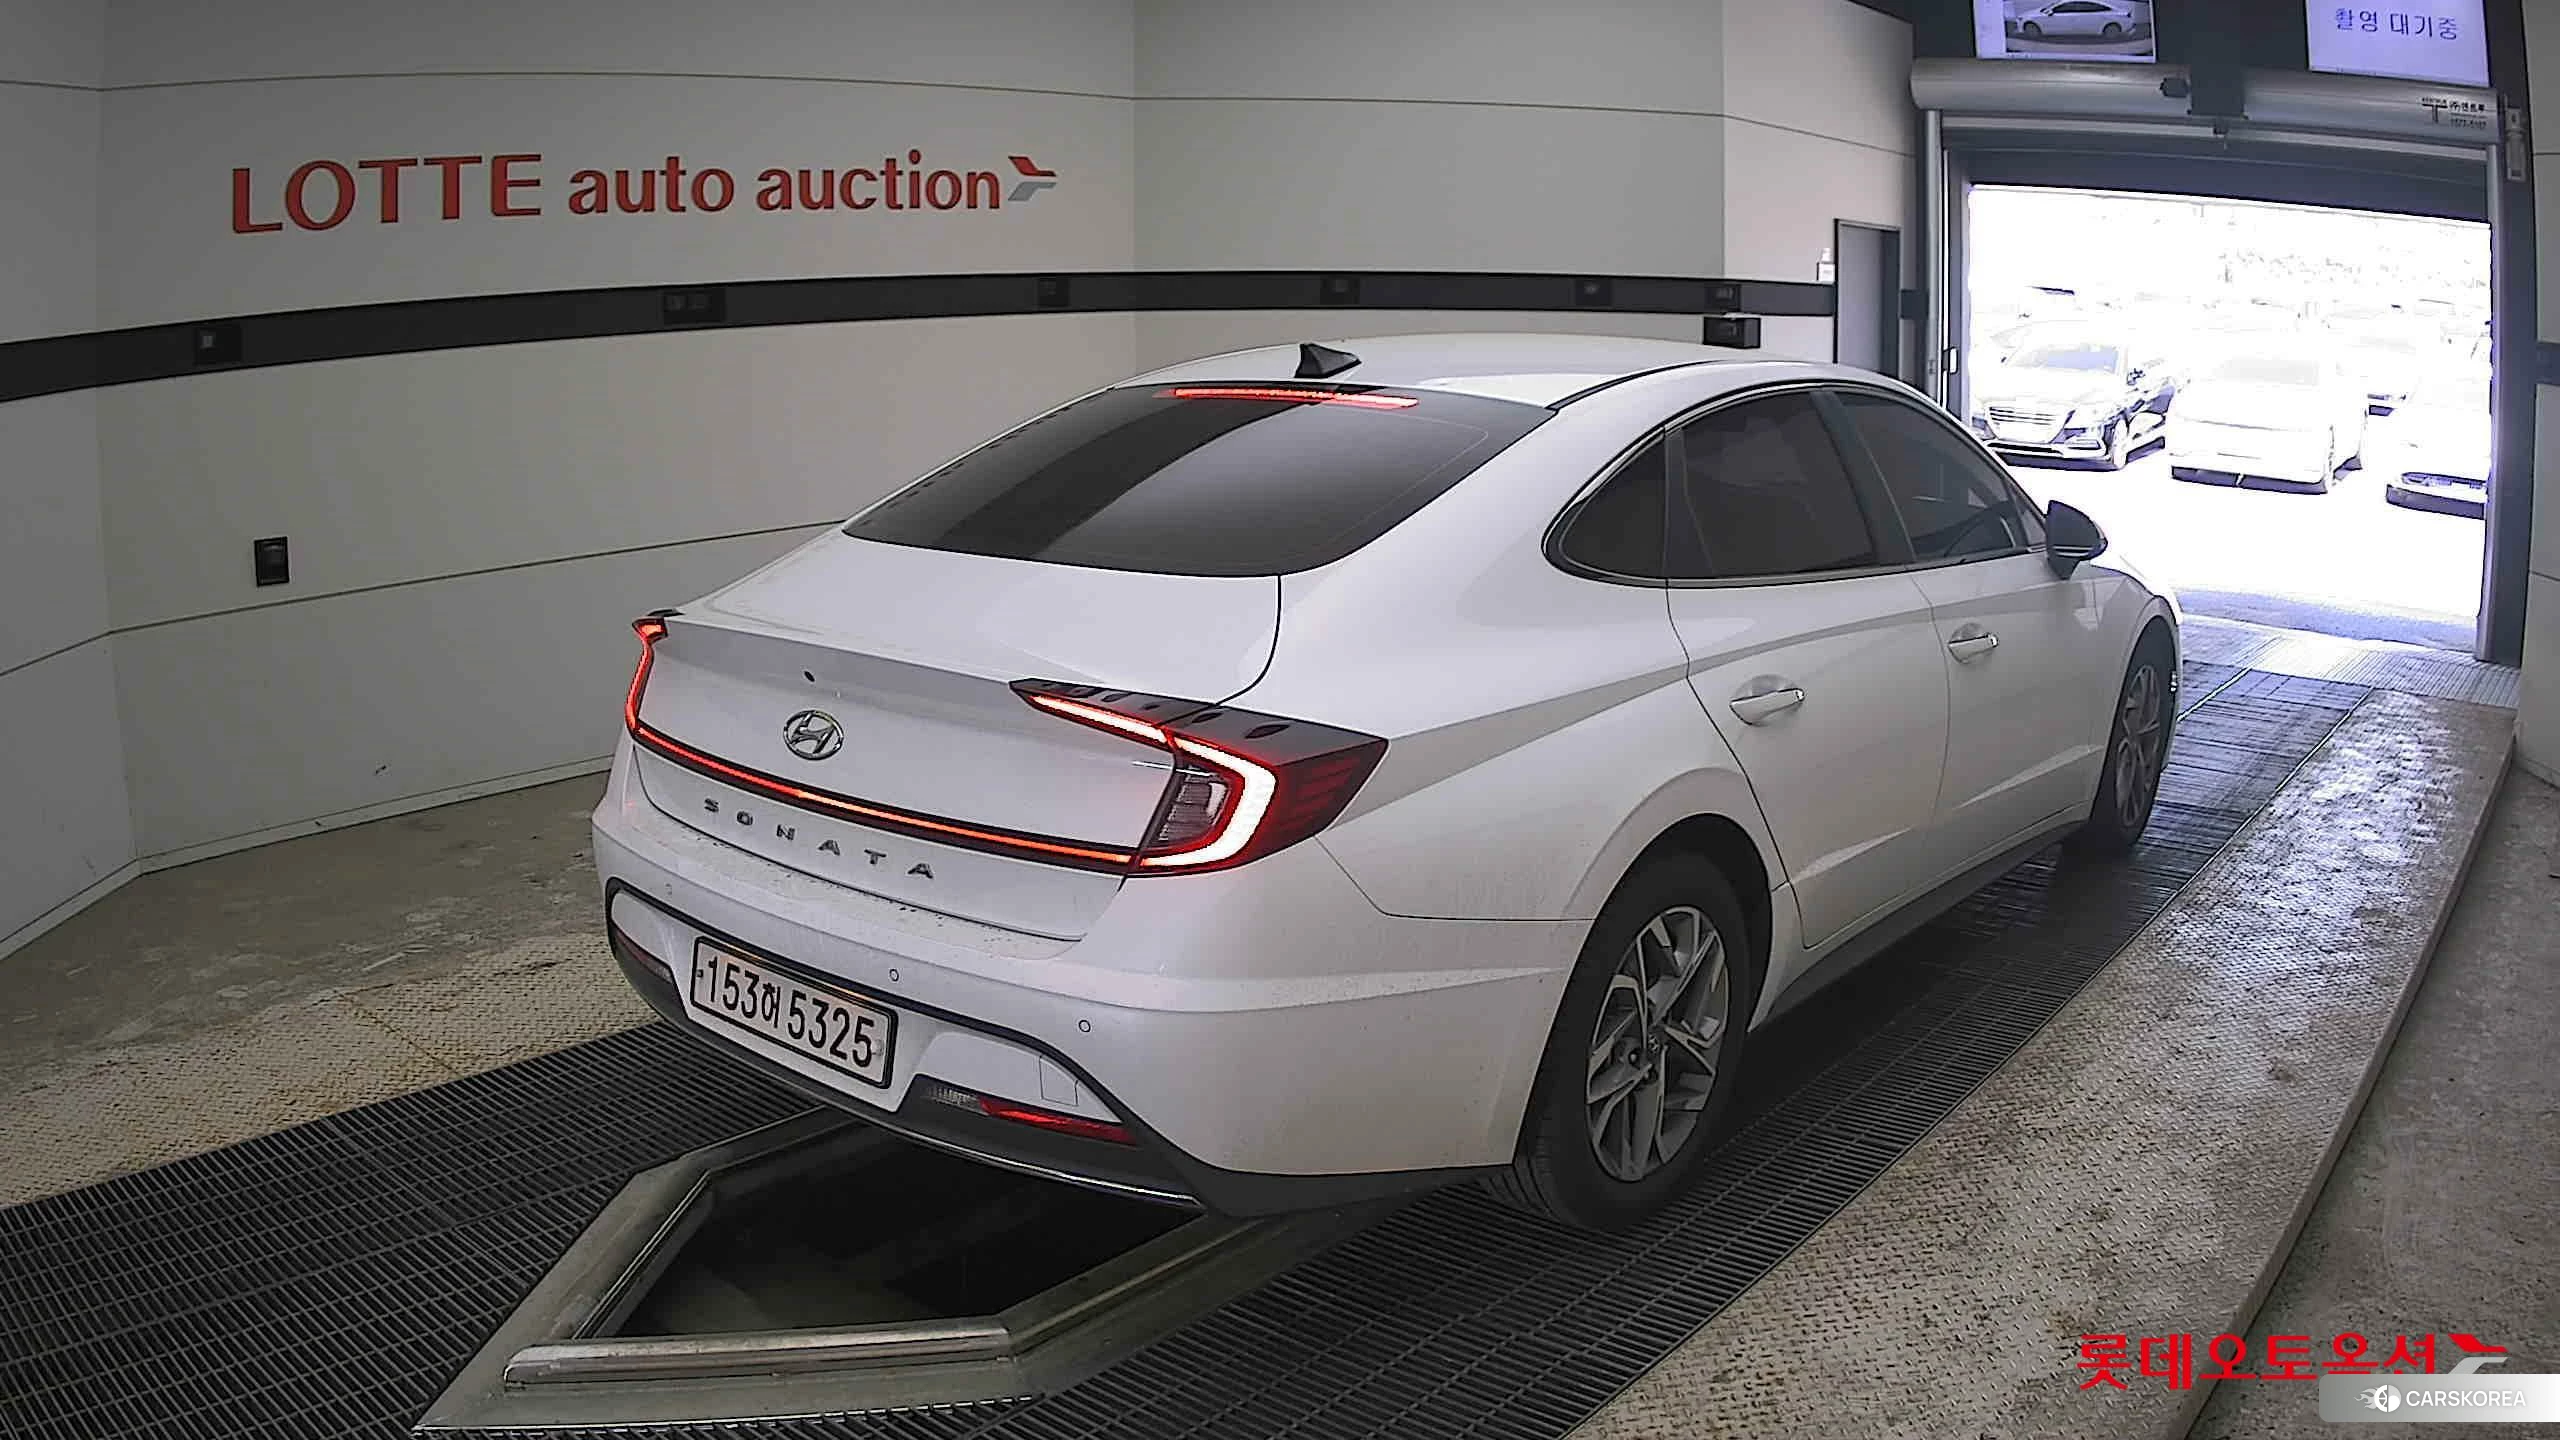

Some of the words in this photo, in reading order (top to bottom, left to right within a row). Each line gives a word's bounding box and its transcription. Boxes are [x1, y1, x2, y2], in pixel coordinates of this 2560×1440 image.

[2334, 6, 2379, 33] 촬영
[2389, 12, 2457, 41] 대기중
[232, 153, 543, 235] LOTTE
[568, 155, 735, 215] auto
[755, 149, 1002, 212] auction
[703, 798, 935, 880] SONATA
